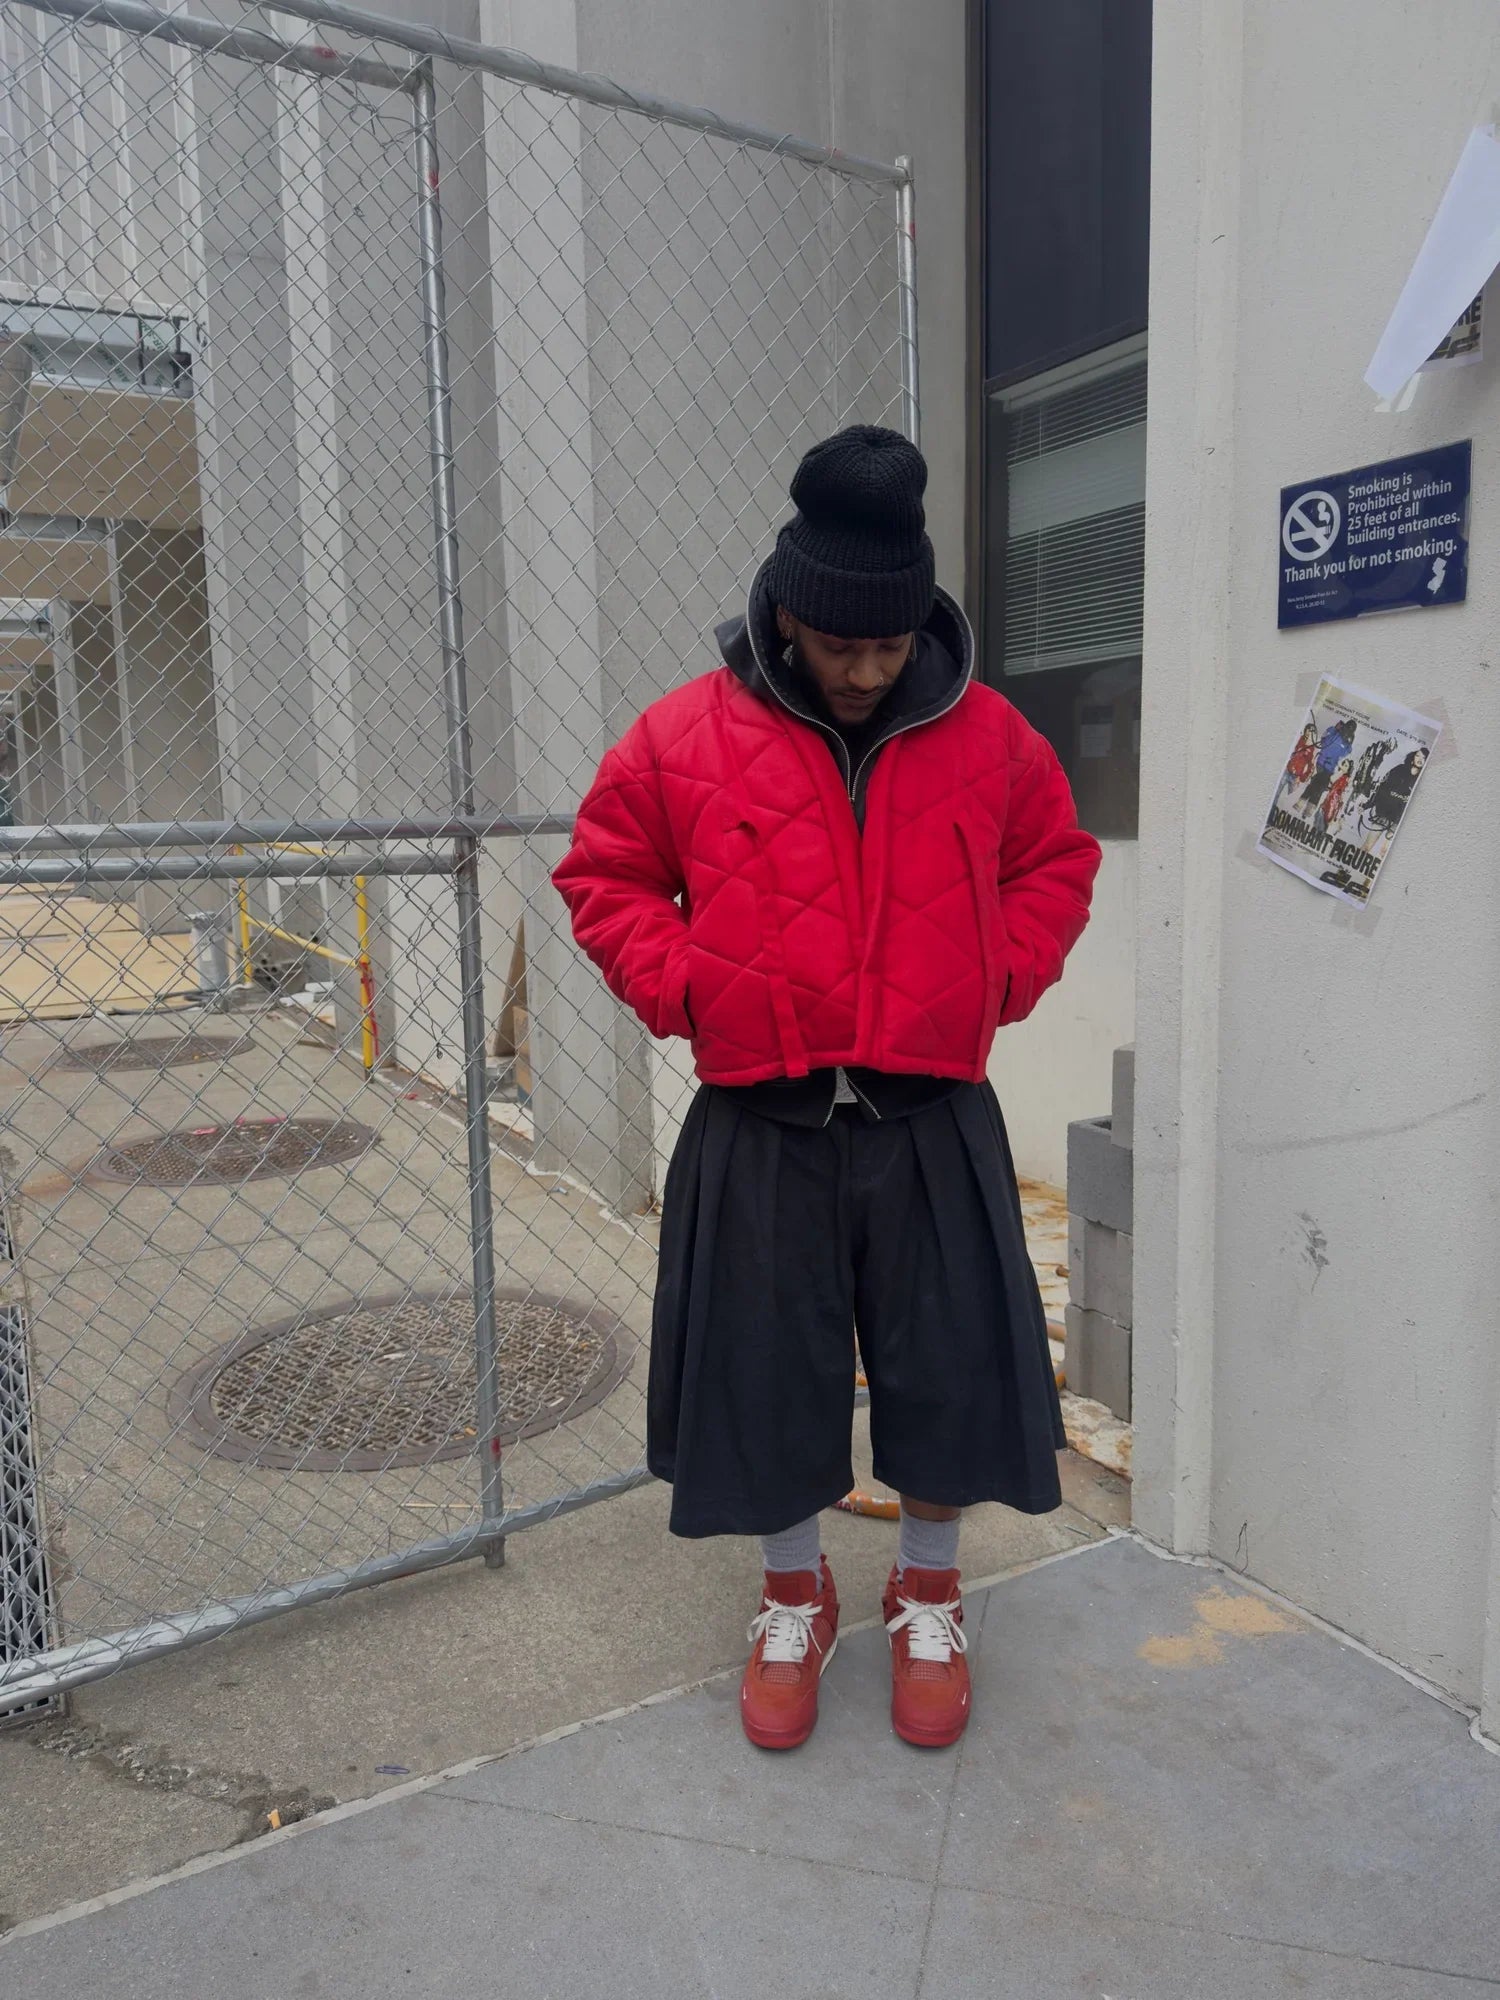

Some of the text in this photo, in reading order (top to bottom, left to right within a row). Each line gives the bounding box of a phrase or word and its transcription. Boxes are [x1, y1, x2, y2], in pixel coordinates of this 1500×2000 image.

[1347, 480, 1452, 516] Prohibited within
[1348, 472, 1413, 499] Smoking is
[1347, 502, 1420, 531] 25 feet of all
[1347, 511, 1461, 546] building entrances.
[1284, 537, 1458, 584] Thank you for not smoking.
[1270, 806, 1333, 854] DOMINANT
[1329, 838, 1382, 879] FIGURE
